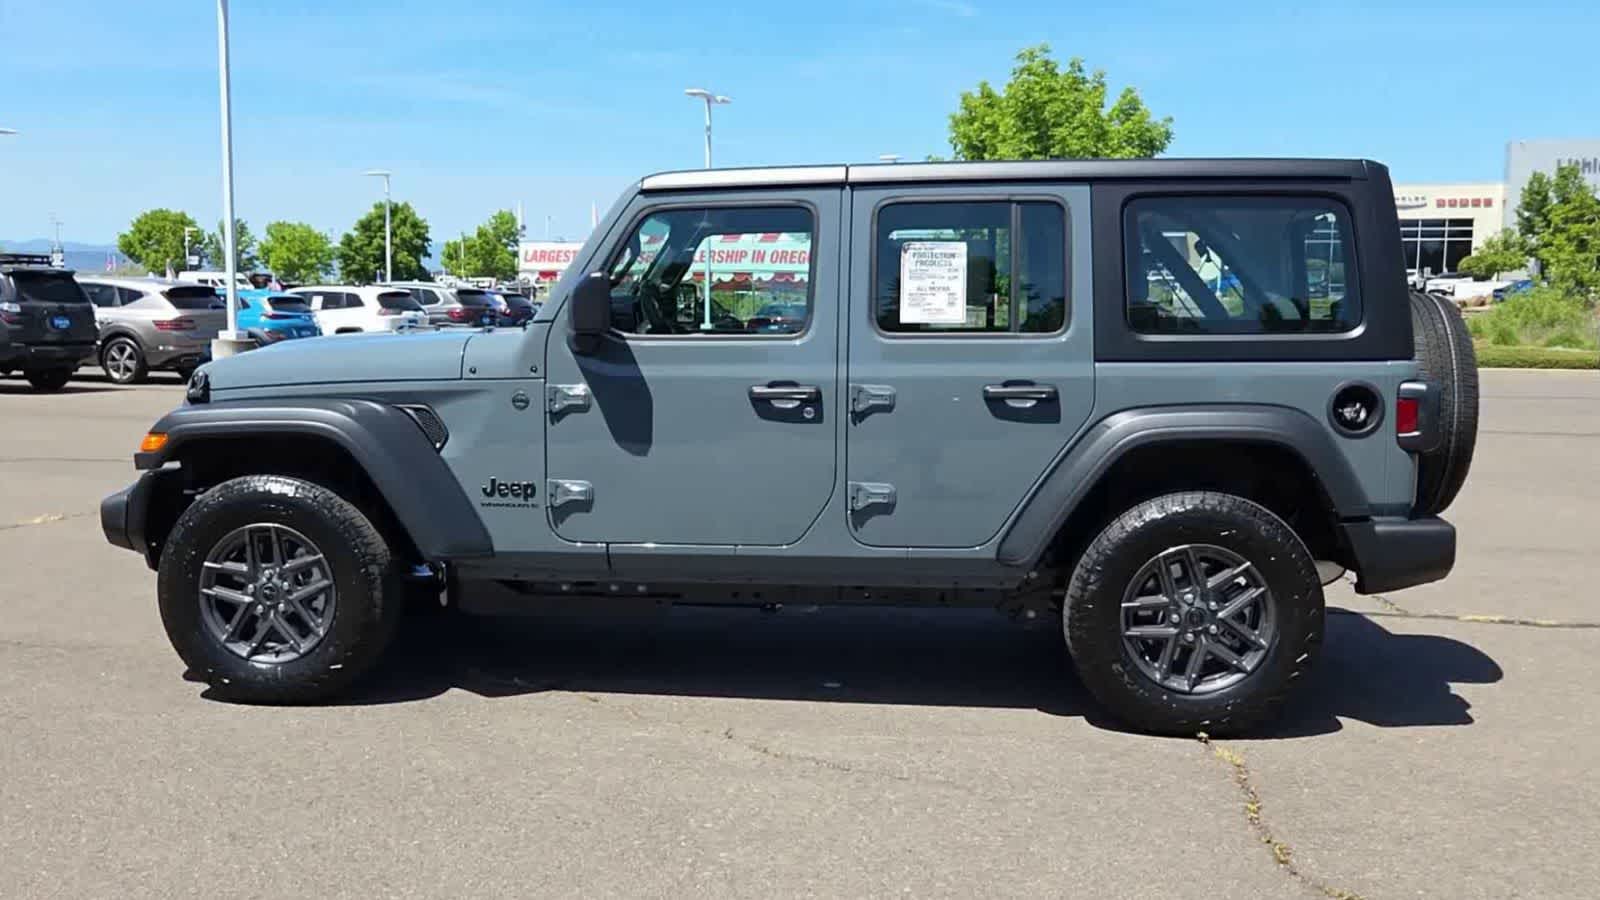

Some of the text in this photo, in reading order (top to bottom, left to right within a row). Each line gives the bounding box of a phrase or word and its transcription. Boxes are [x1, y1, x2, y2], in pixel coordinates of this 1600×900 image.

[1556, 157, 1600, 174] Lhi
[524, 249, 577, 262] LARGEST
[751, 249, 766, 263] IN
[482, 476, 537, 502] Jeep
